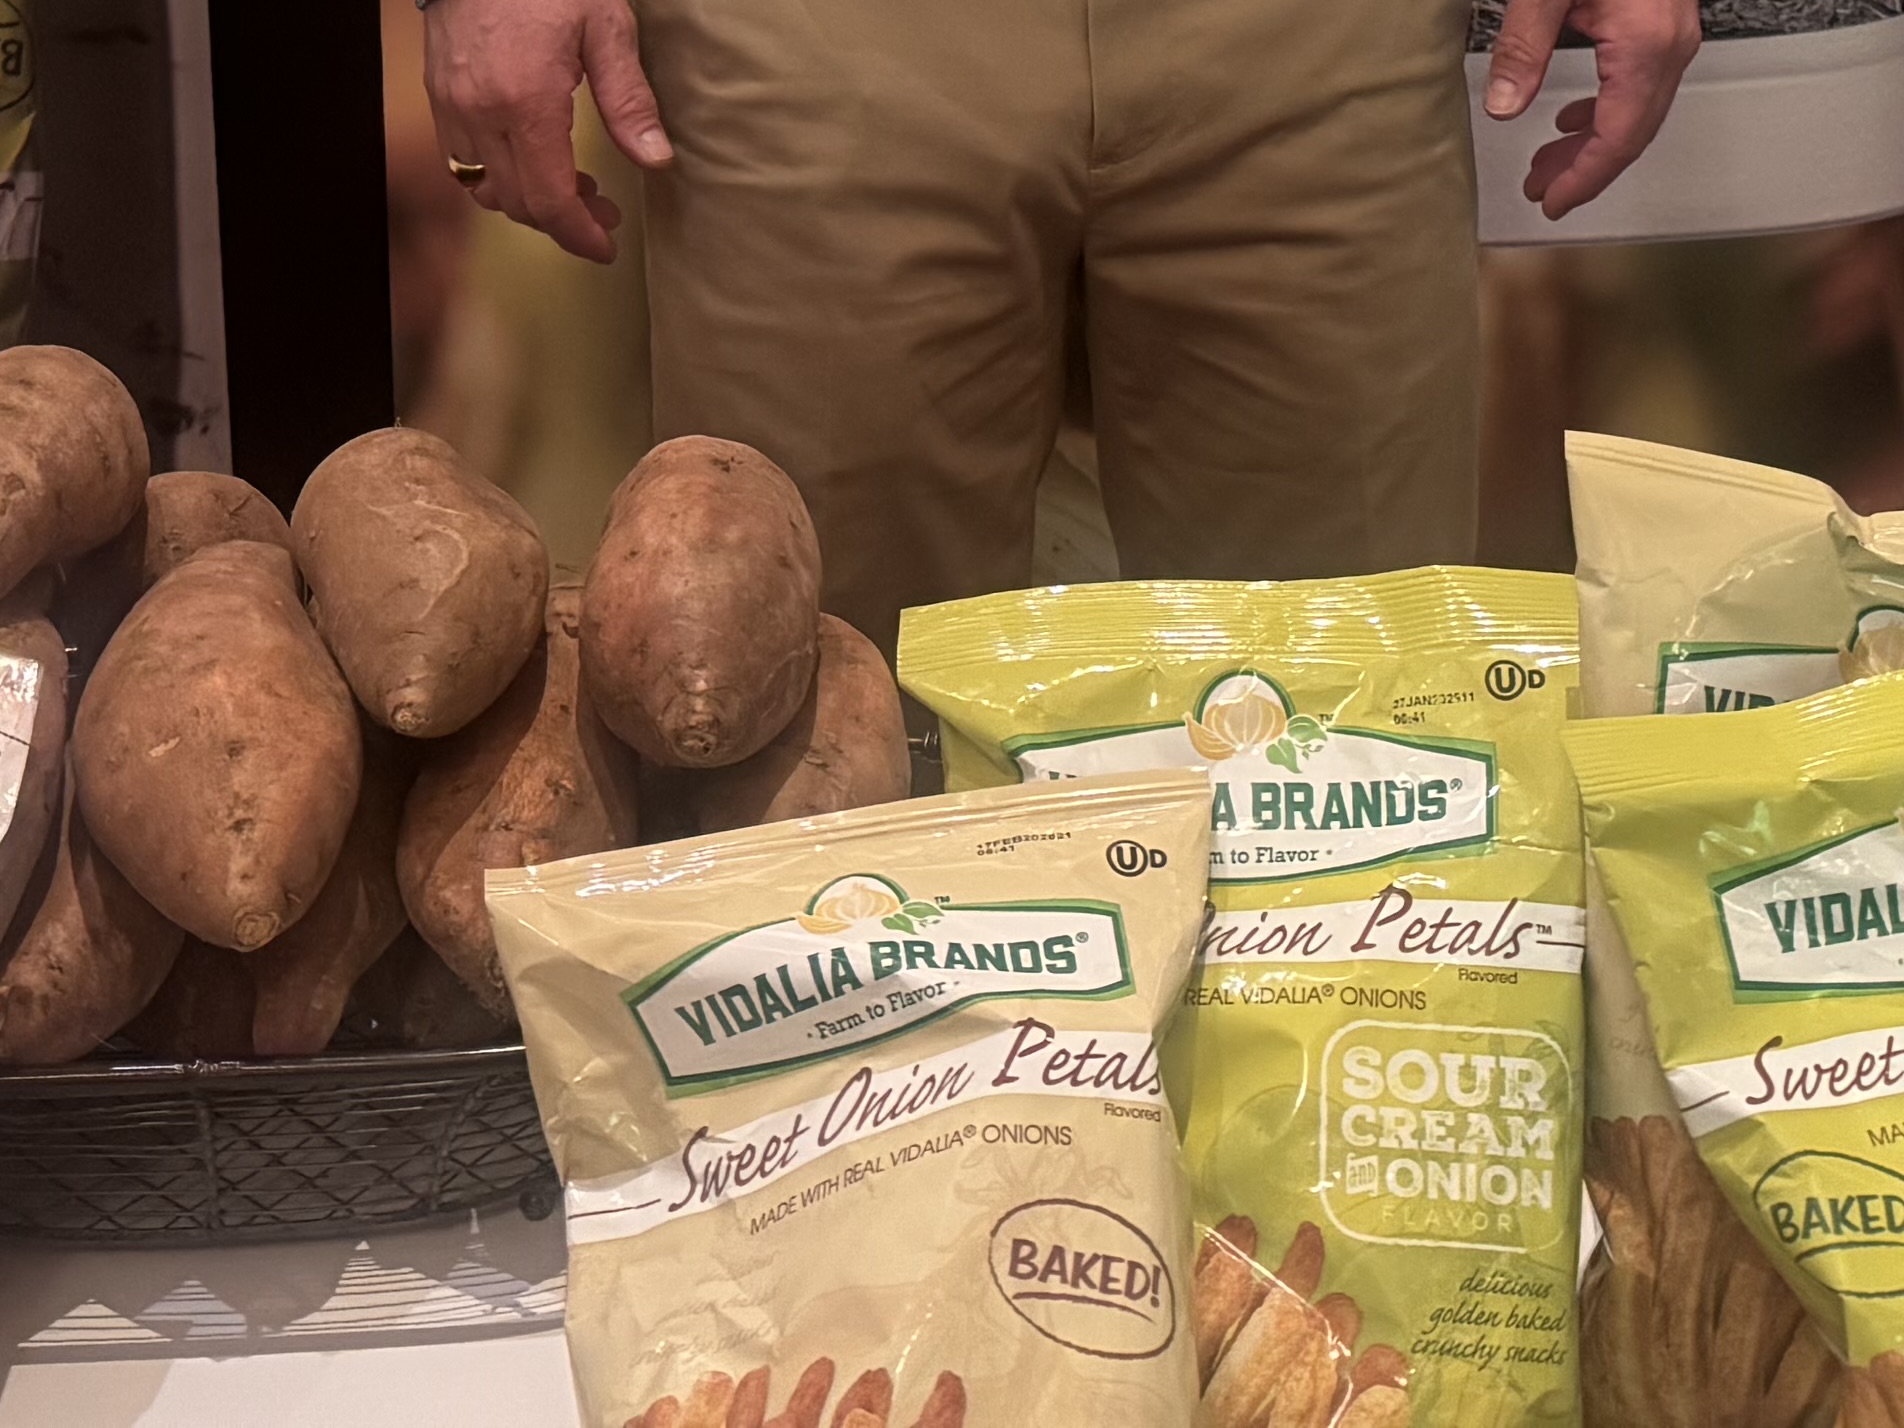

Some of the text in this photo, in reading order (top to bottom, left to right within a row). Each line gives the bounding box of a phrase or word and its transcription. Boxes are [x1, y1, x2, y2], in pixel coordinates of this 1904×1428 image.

[1231, 846, 1318, 865] to Flavor
[674, 947, 864, 1047] VIDALIA
[815, 980, 948, 1042] Farm to Flavor
[1183, 989, 1234, 1006] REAL
[1341, 988, 1427, 1009] ONIONS
[1342, 1045, 1547, 1112] SOUR
[669, 1017, 1161, 1213] Sweet Onion Petals
[1104, 1103, 1161, 1123] Flavored
[1341, 1104, 1554, 1161] CREAM
[749, 1193, 799, 1236] MADE
[797, 1173, 842, 1217] WITH
[842, 1155, 886, 1193] REAL
[981, 1124, 1072, 1148] ONIONS
[1386, 1158, 1553, 1209] ONION
[1381, 1206, 1513, 1233] FLAVOR
[1007, 1237, 1161, 1309] BAKED!
[1460, 1268, 1553, 1299] delicious
[1422, 1302, 1567, 1335] golden baked
[1411, 1334, 1568, 1371] crunchy snacks
